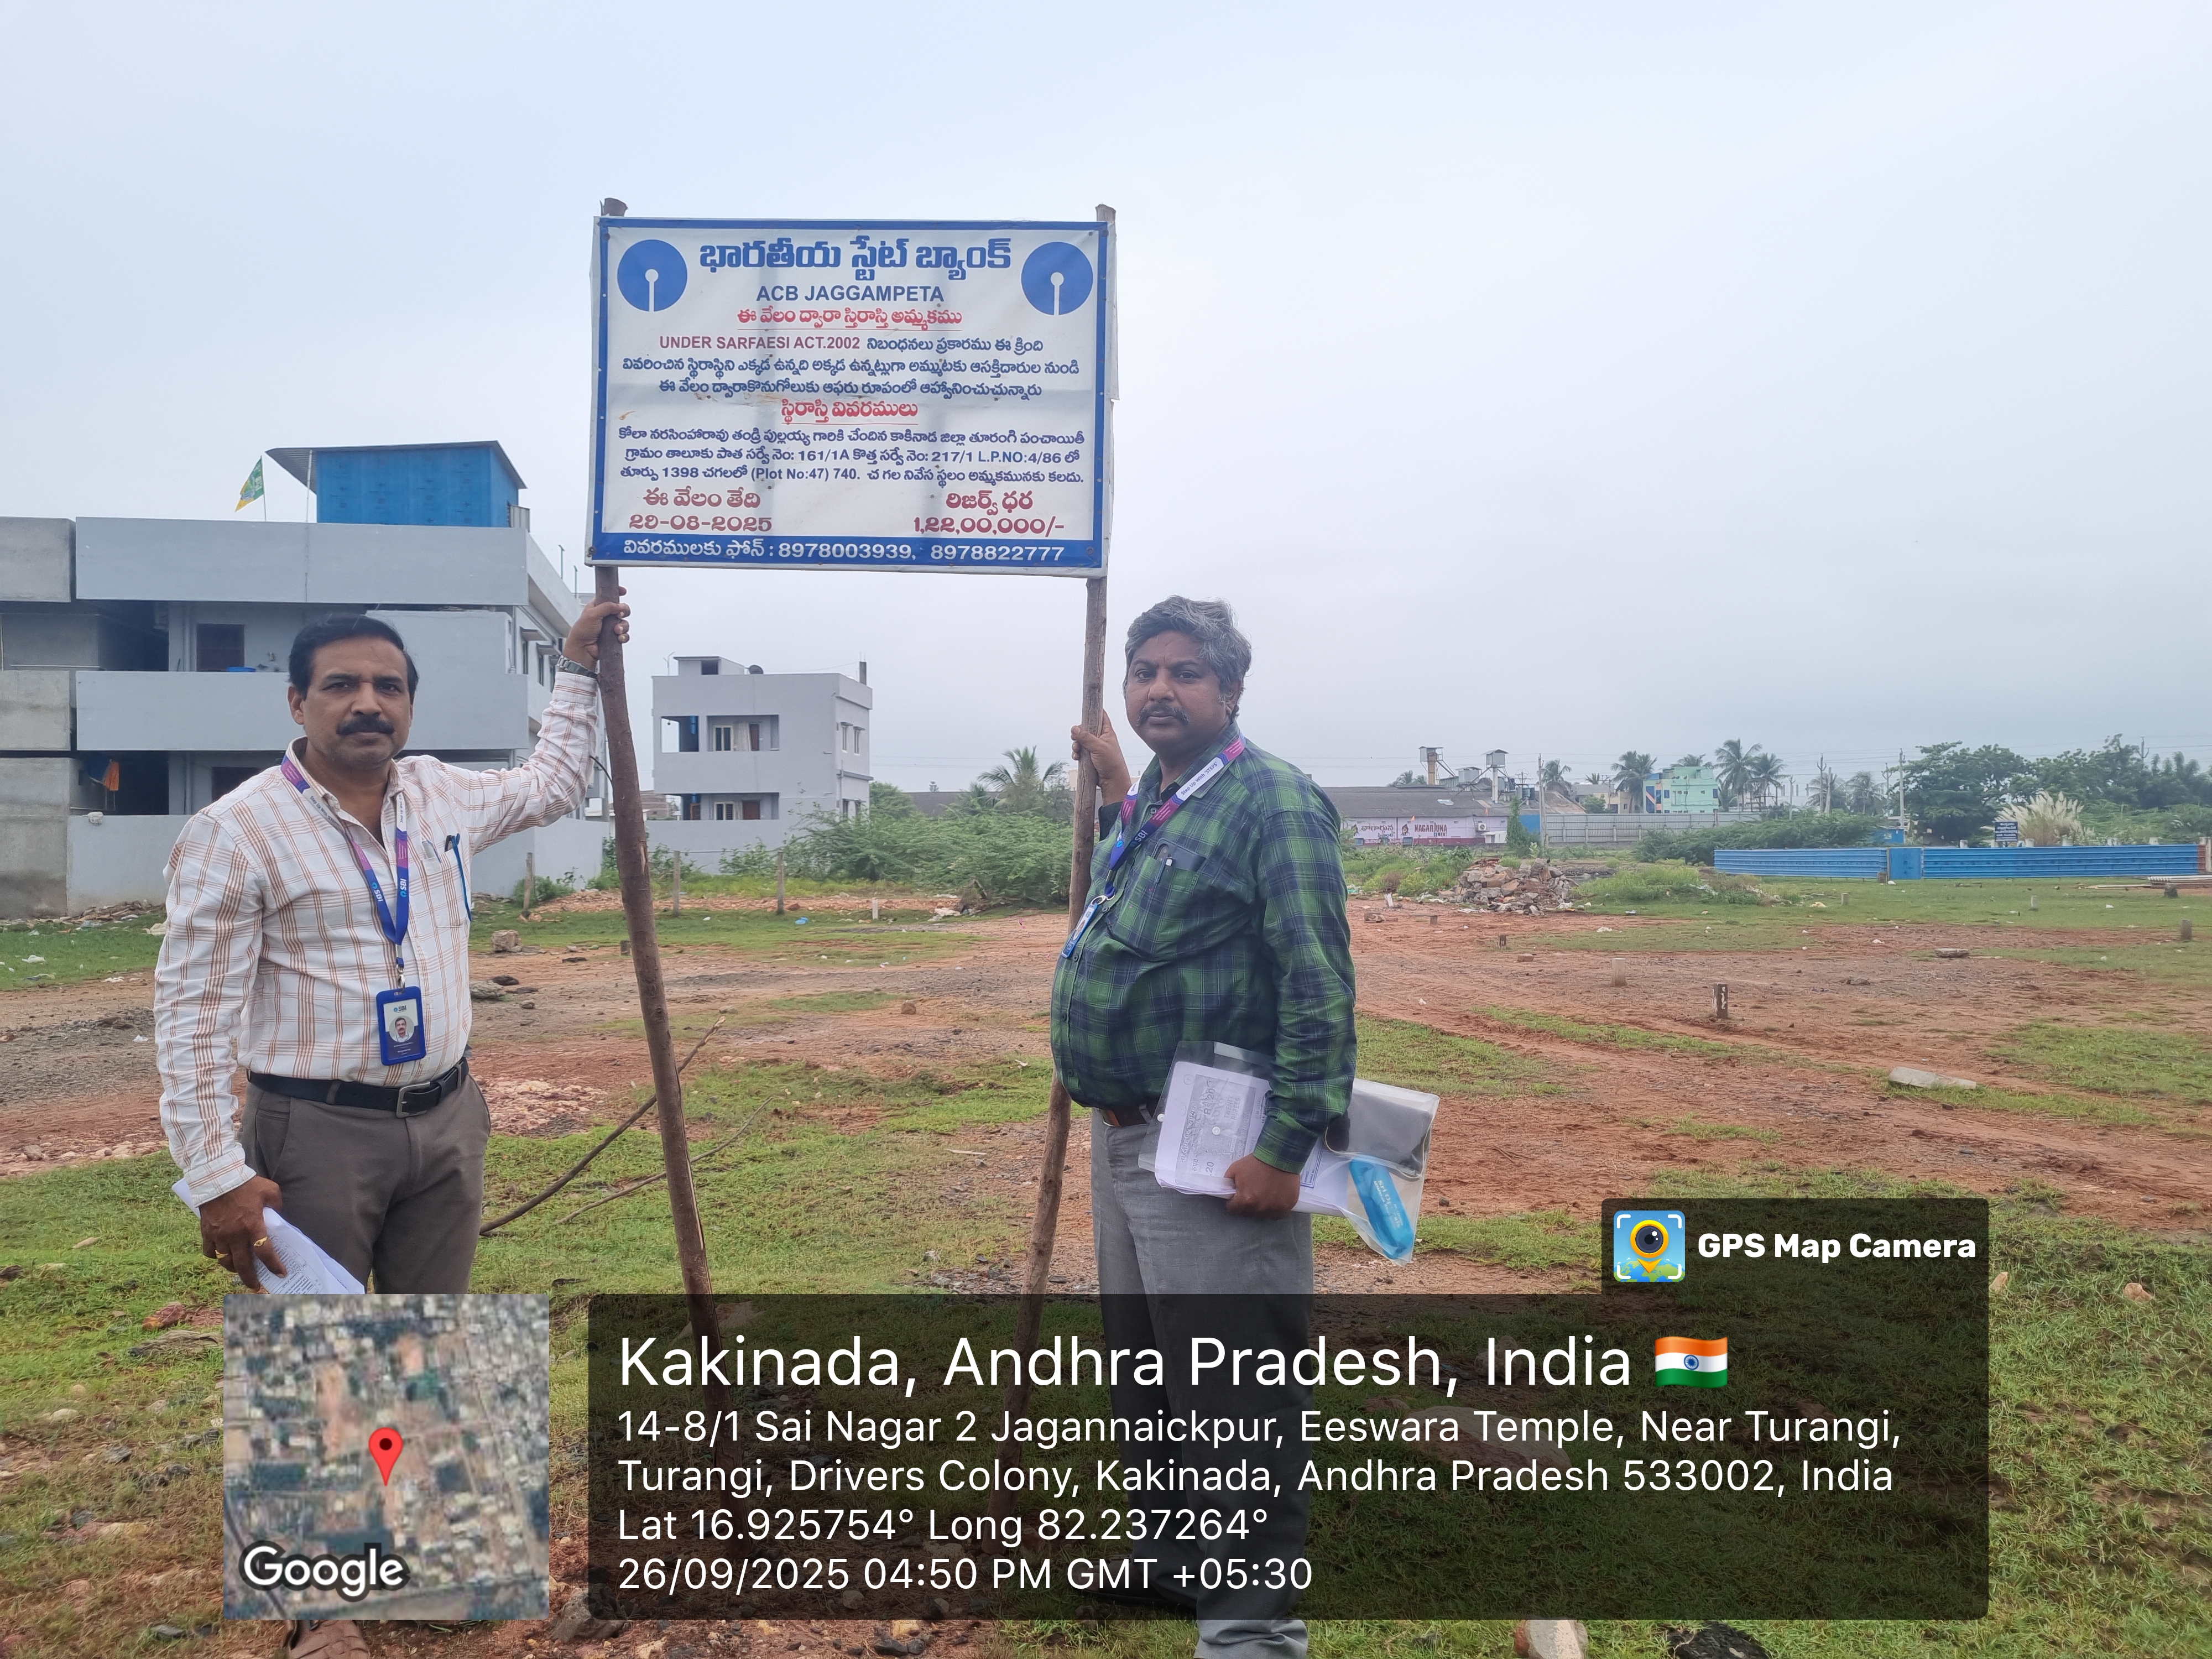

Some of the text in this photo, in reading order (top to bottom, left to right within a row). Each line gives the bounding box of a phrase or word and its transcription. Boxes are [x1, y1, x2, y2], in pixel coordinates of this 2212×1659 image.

[700, 235, 1011, 281] భారతీయ స్టేట్ బ్యాంక్
[757, 285, 945, 302] ACB JAGGAMPETA
[737, 309, 757, 323] ఈ
[760, 305, 796, 323] వేలం
[799, 310, 841, 328] ద్వారా
[891, 309, 962, 331] అమ్మకము
[660, 336, 1044, 356] UNDER SARFAESI ACT.2002 నిబంధనలు ప్రకారము ఈ క్రింది
[622, 358, 685, 370] వివరించిన
[738, 358, 771, 375] ఎక్కడ
[774, 358, 809, 375] ఉన్నది
[812, 358, 846, 376] అక్కడ
[848, 358, 906, 376] ఉన్నట్లుగా
[909, 359, 967, 377] అమ్ముటకు
[970, 358, 1041, 378] ఆసక్తిదారుల
[1044, 359, 1080, 375] నుండి
[659, 379, 676, 392] ఈ
[679, 377, 709, 393] వేలం
[823, 380, 859, 396] ఆఫరు
[861, 378, 917, 394] రూపంలో
[781, 398, 919, 424] స్థిరాస్తి వివరములు
[618, 425, 1085, 446] కోలా నరసింహారావు తండ్రి పుల్లయ్య గారికి చేందిన కాకినాడ జిల్లా తూరంగి పంచాయితీ
[624, 445, 1080, 466] గ్రామం తాలూకు పాత సర్వే నెం: 161/1A కొత్త సర్వే నెం: 217/1 L.P.NO:4/86 లో
[620, 465, 1084, 489] తూర్పు 1398 చగలలో (Plot No:47) 740. చ గల నివేస స్థలం అమ్మకమునకు కలదు.
[643, 485, 761, 508] ఈ వేలం తేది
[946, 490, 1034, 516] రిజర్వ్ ధర
[629, 514, 773, 532] 29-08-2025
[914, 516, 1065, 538] 1,22,00,000/-
[623, 538, 722, 556] వివరములకు
[727, 538, 765, 560] ఫోన్
[778, 543, 916, 561] 8978003939,
[930, 545, 1065, 561] 8978822777
[1134, 830, 1148, 842] SBI
[1414, 822, 1447, 833] NAGARJUNA
[374, 889, 384, 902] SBI
[1203, 1088, 1215, 1115] Rs.20
[1232, 1098, 1241, 1120] RUPEES
